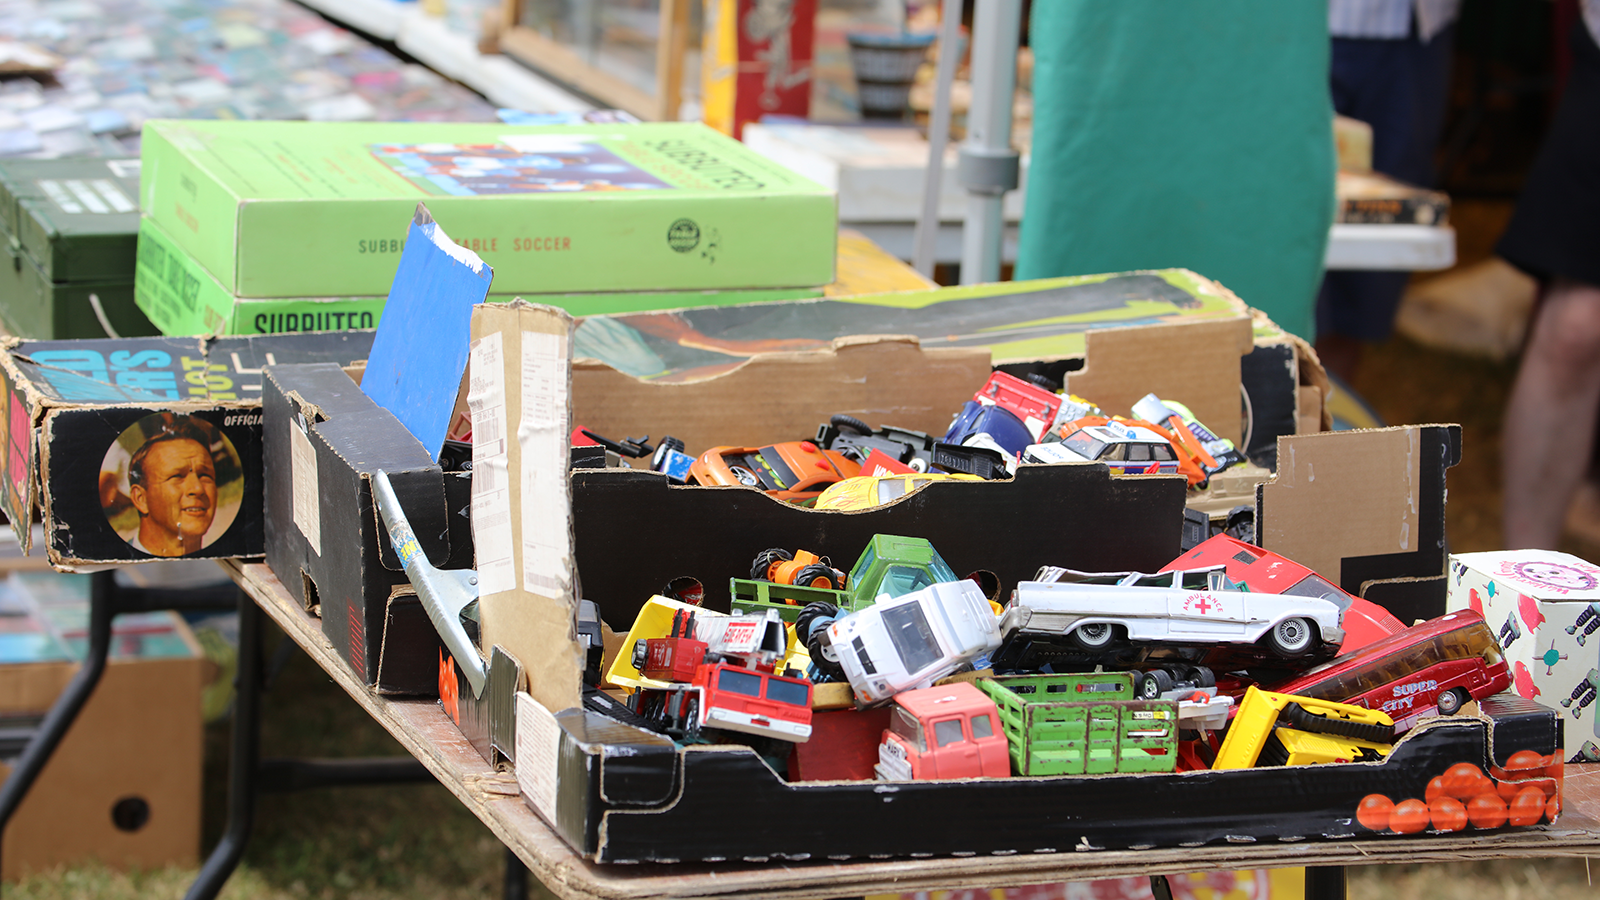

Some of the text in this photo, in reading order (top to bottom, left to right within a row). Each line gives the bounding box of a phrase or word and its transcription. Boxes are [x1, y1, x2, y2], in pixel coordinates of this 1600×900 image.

[513, 237, 572, 251] SOCCER
[223, 414, 264, 427] OFFICIA
[1183, 593, 1224, 613] AMBULANCE
[1392, 679, 1438, 697] SUPER
[1382, 696, 1415, 712] CITY
